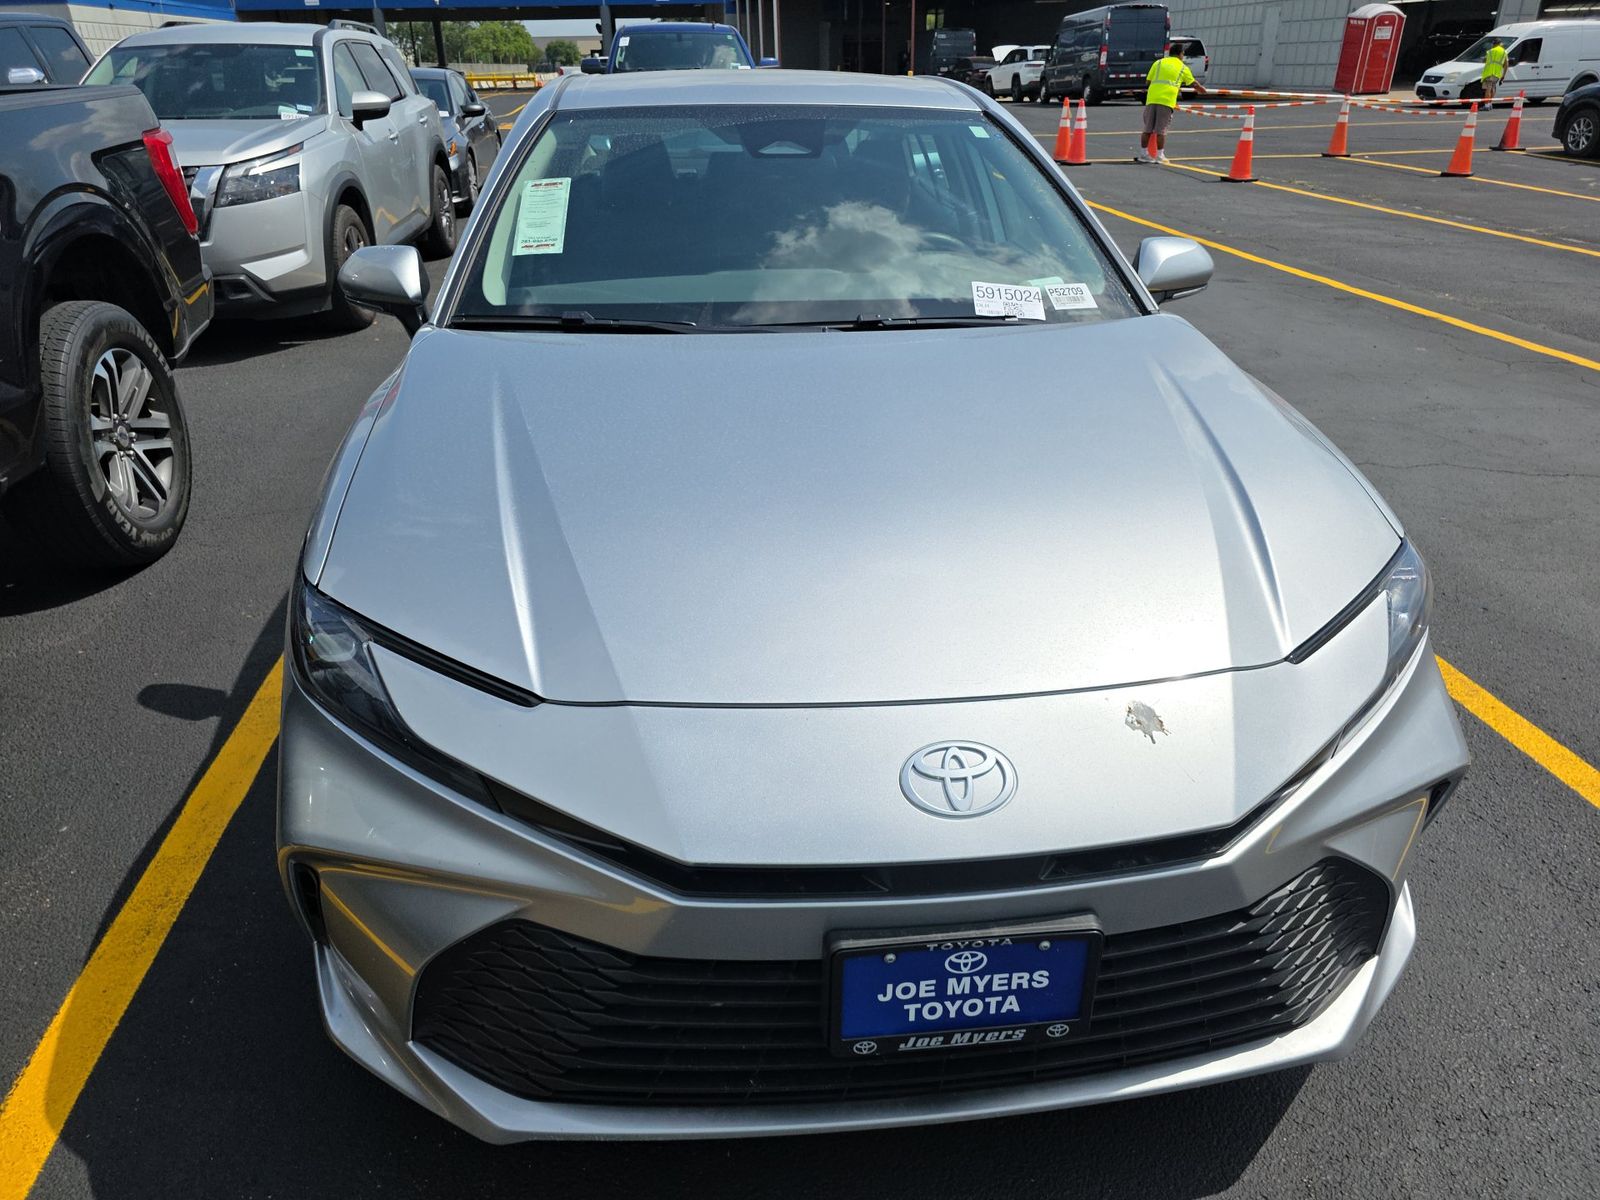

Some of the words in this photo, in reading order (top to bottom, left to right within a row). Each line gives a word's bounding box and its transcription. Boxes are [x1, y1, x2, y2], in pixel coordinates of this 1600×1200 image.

[977, 286, 1042, 304] 5915024
[1049, 287, 1084, 297] P52709
[926, 937, 1014, 952] TOYOTA
[877, 979, 937, 1003] JOE
[946, 969, 1050, 996] MYERS
[903, 995, 1021, 1022] TOYOTA
[898, 1034, 944, 1050] Joe
[950, 1027, 1027, 1045] Myers
